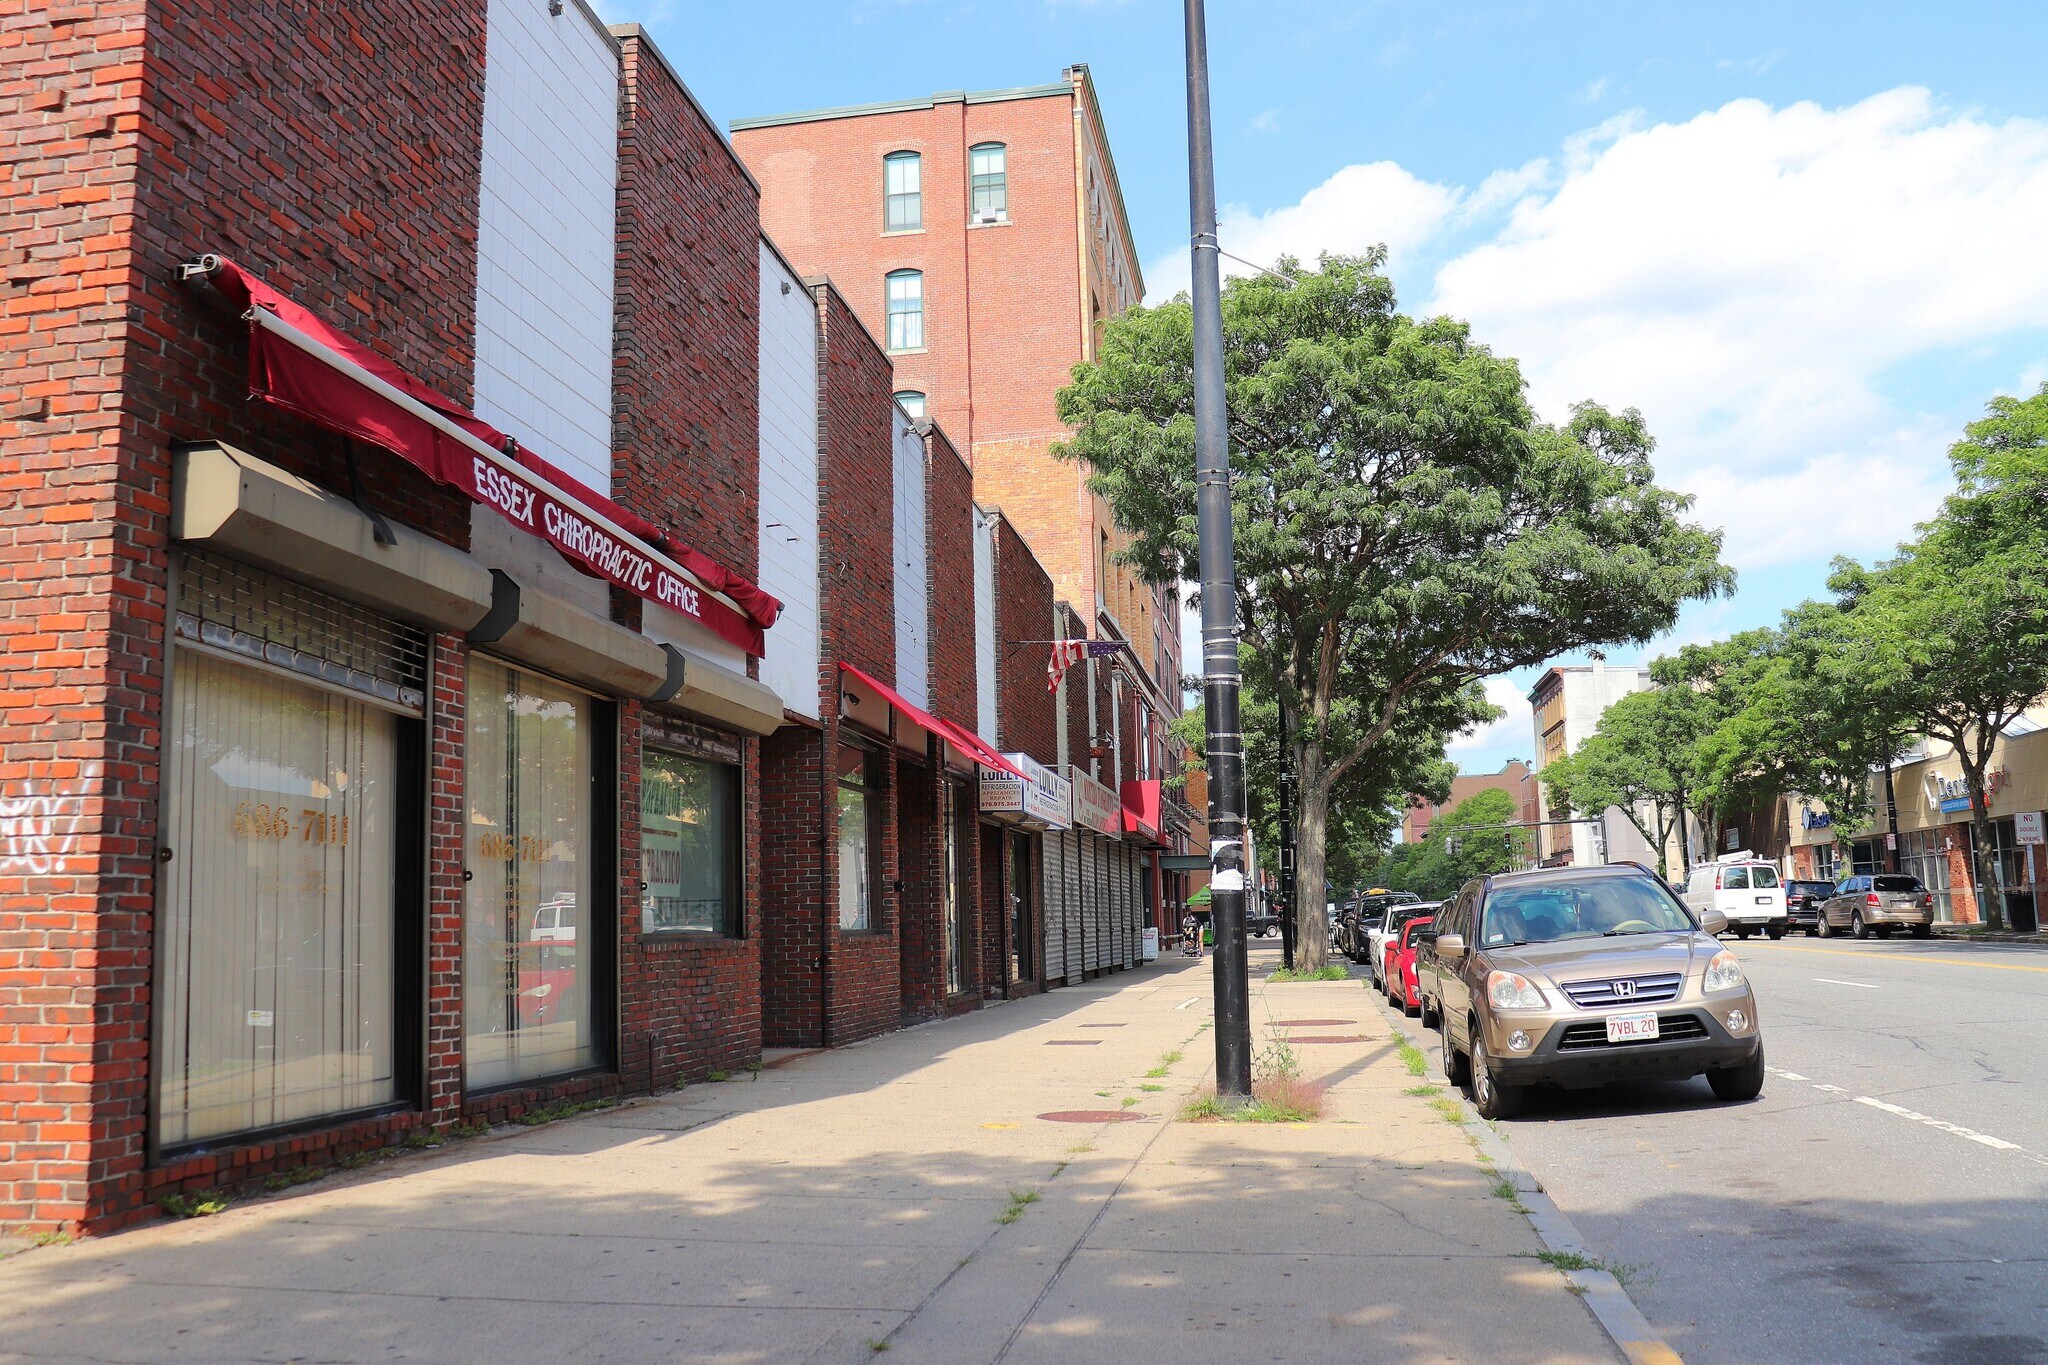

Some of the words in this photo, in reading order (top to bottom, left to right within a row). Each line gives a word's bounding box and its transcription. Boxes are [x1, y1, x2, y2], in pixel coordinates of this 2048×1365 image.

[473, 457, 537, 527] ESSEX
[543, 503, 653, 591] CHIROPRACTIC
[657, 571, 700, 617] OFFICE
[1039, 768, 1058, 798] LUILLY
[1938, 775, 1970, 798] Denta
[234, 800, 349, 846] 686-7111
[1609, 1021, 1638, 1035] 7VBL
[1641, 1019, 1655, 1033] 20
